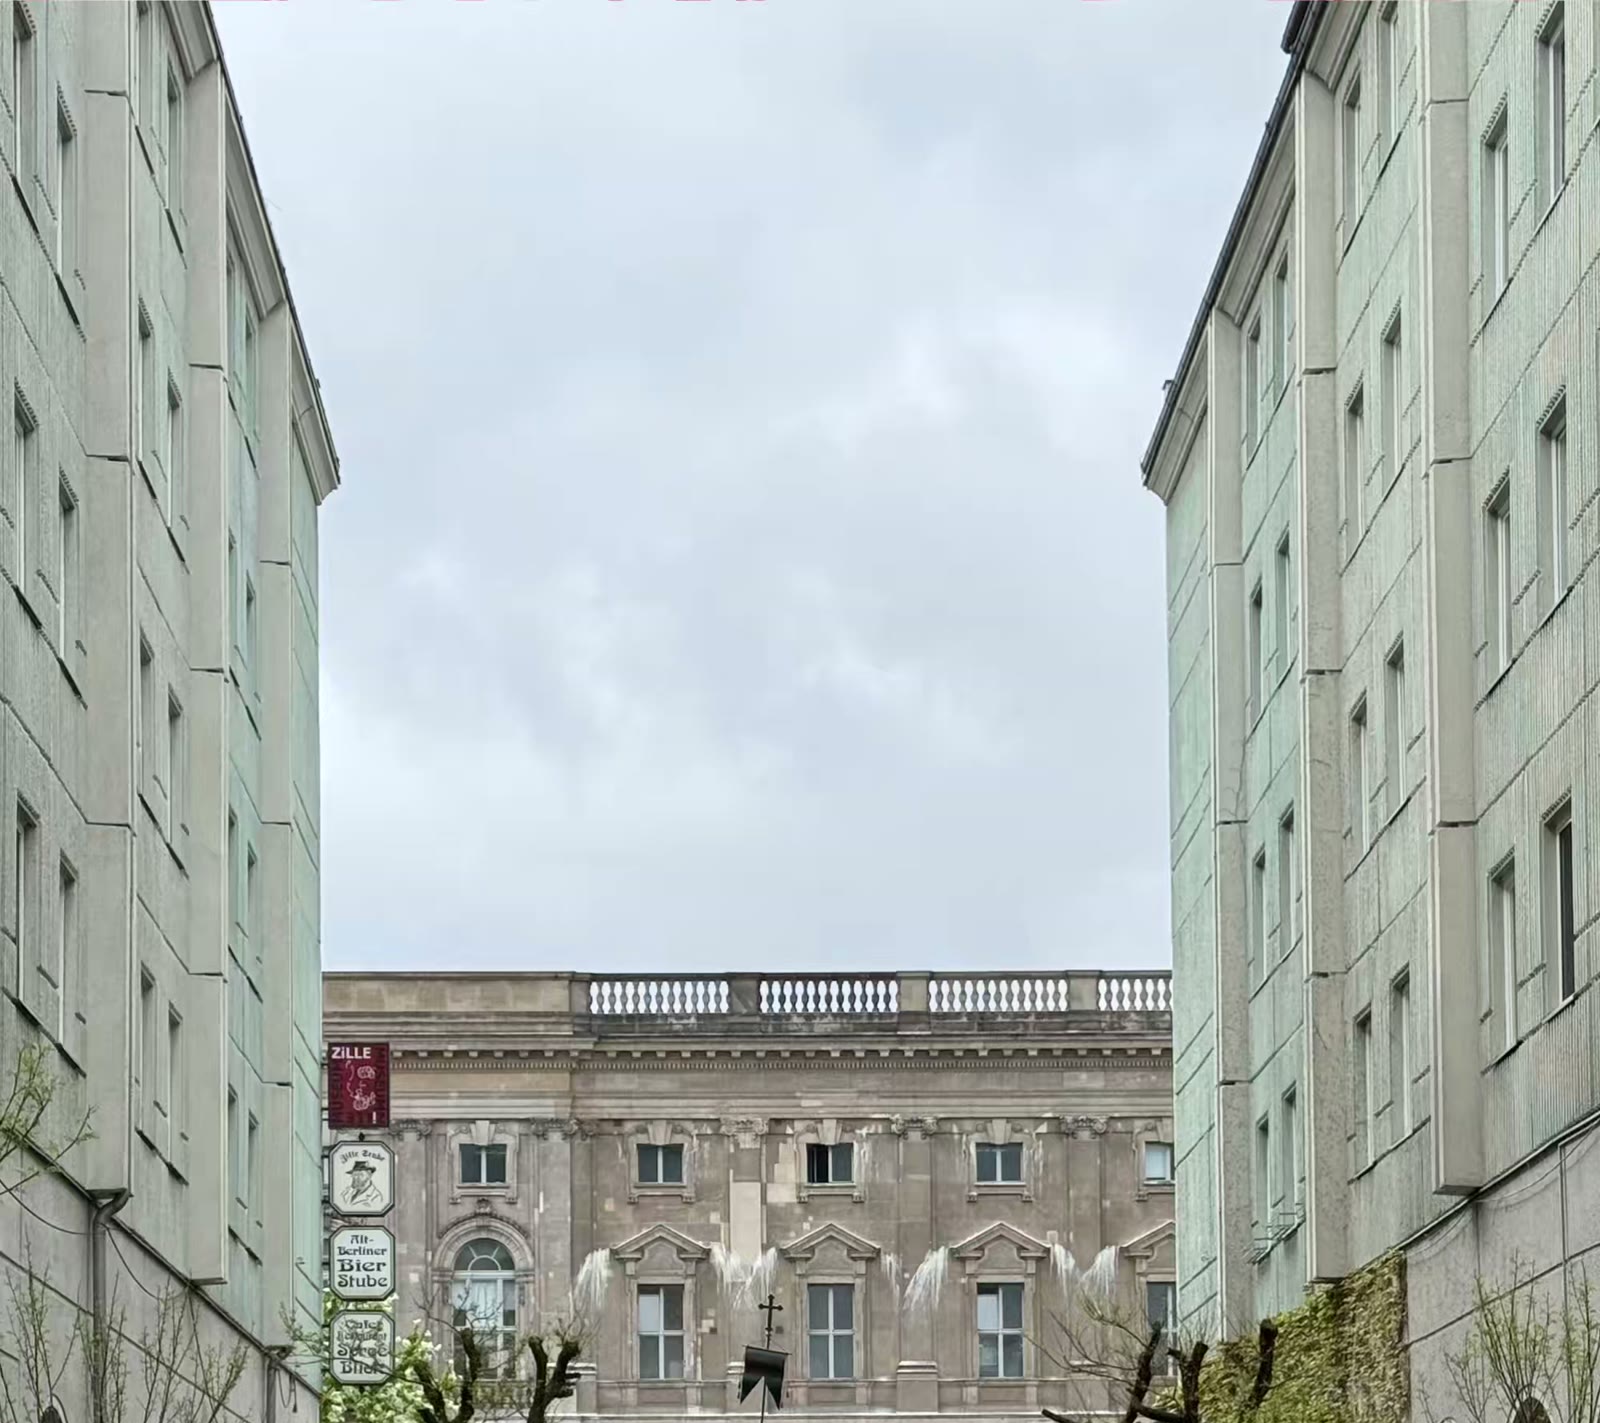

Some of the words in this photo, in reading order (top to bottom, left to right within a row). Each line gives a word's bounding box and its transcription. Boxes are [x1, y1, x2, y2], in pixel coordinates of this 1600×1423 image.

[350, 1234, 374, 1245] Alt-
[337, 1246, 387, 1256] Berliner
[337, 1259, 386, 1272] Bier
[337, 1274, 388, 1287] Stube
